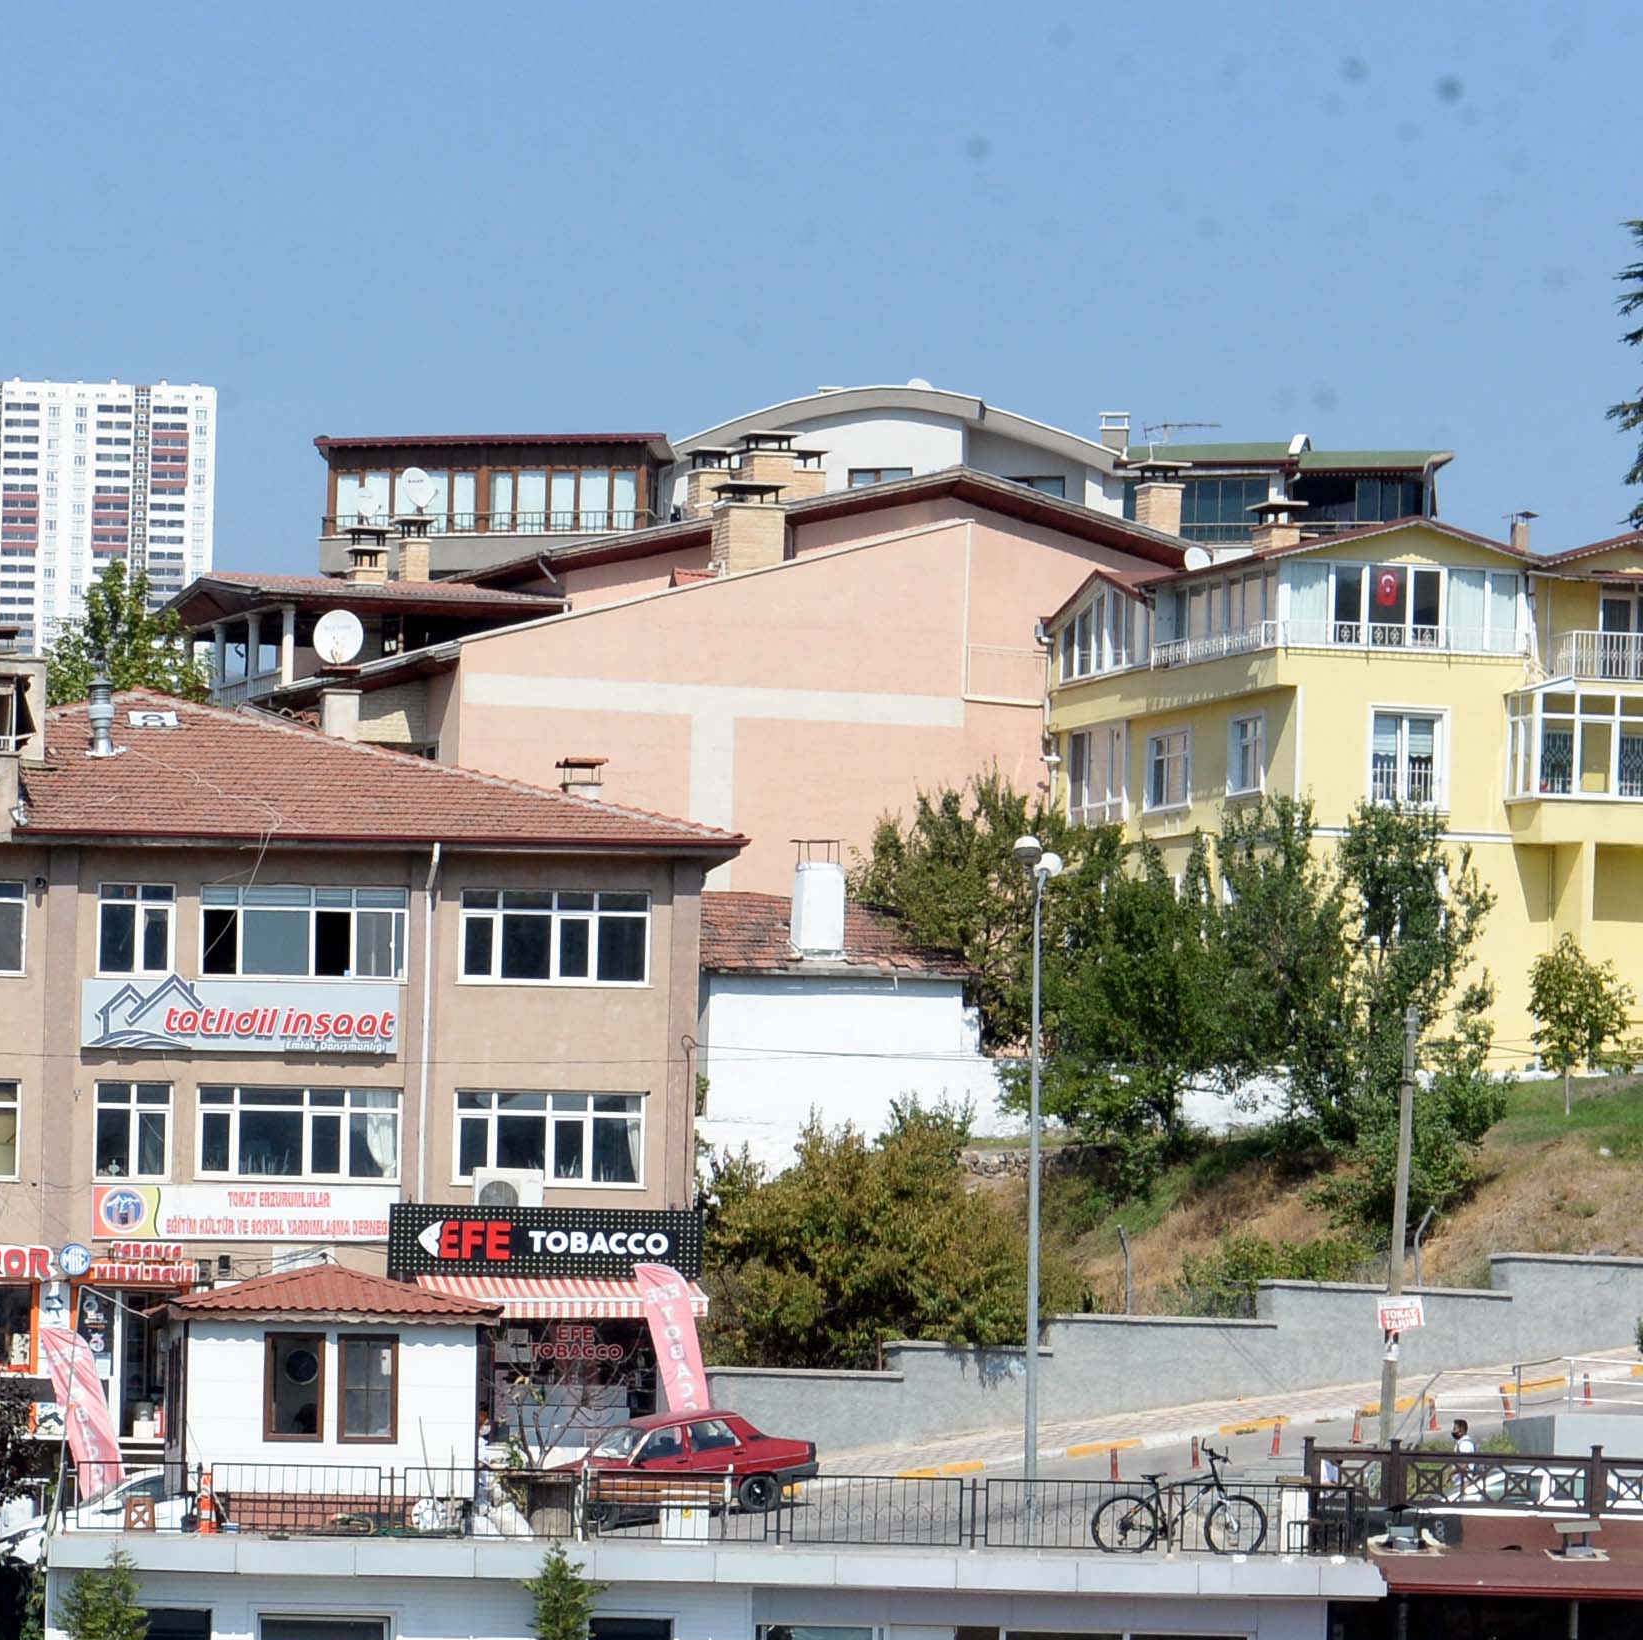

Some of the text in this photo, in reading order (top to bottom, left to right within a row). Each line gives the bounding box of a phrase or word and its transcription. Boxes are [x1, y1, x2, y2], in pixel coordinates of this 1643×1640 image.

[164, 1005, 396, 1041] tatlıdil inşaat
[285, 1040, 317, 1051] Emlak
[227, 1191, 257, 1208] TOKAT
[199, 1215, 235, 1235] KÜLTÜR
[236, 1219, 249, 1235] VE
[251, 1219, 285, 1235] SOSYAL
[440, 1220, 669, 1259] EFE TOBACCO
[556, 1325, 595, 1342] EFE
[530, 1342, 624, 1361] TOBACCO
